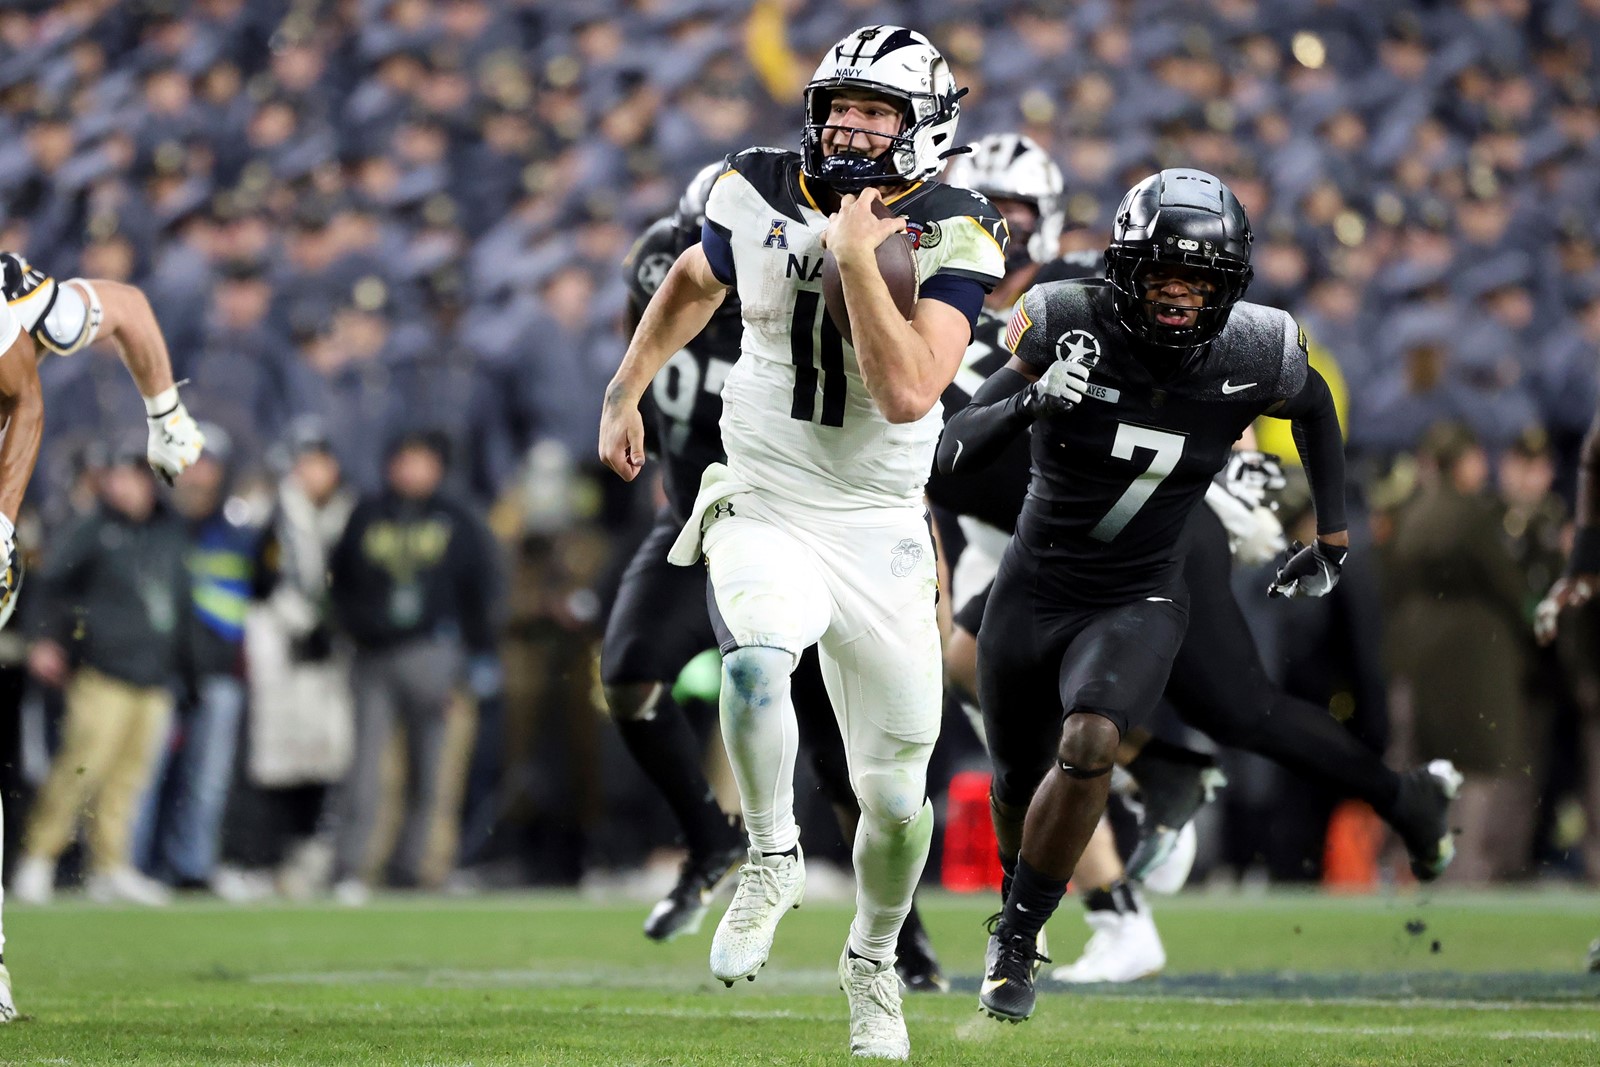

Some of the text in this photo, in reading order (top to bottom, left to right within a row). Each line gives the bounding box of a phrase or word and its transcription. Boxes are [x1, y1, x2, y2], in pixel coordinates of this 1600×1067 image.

[835, 68, 862, 78] NAVY
[785, 253, 824, 282] NA
[790, 289, 847, 428] 11
[1086, 384, 1107, 399] AYES
[1088, 422, 1186, 543] 7
